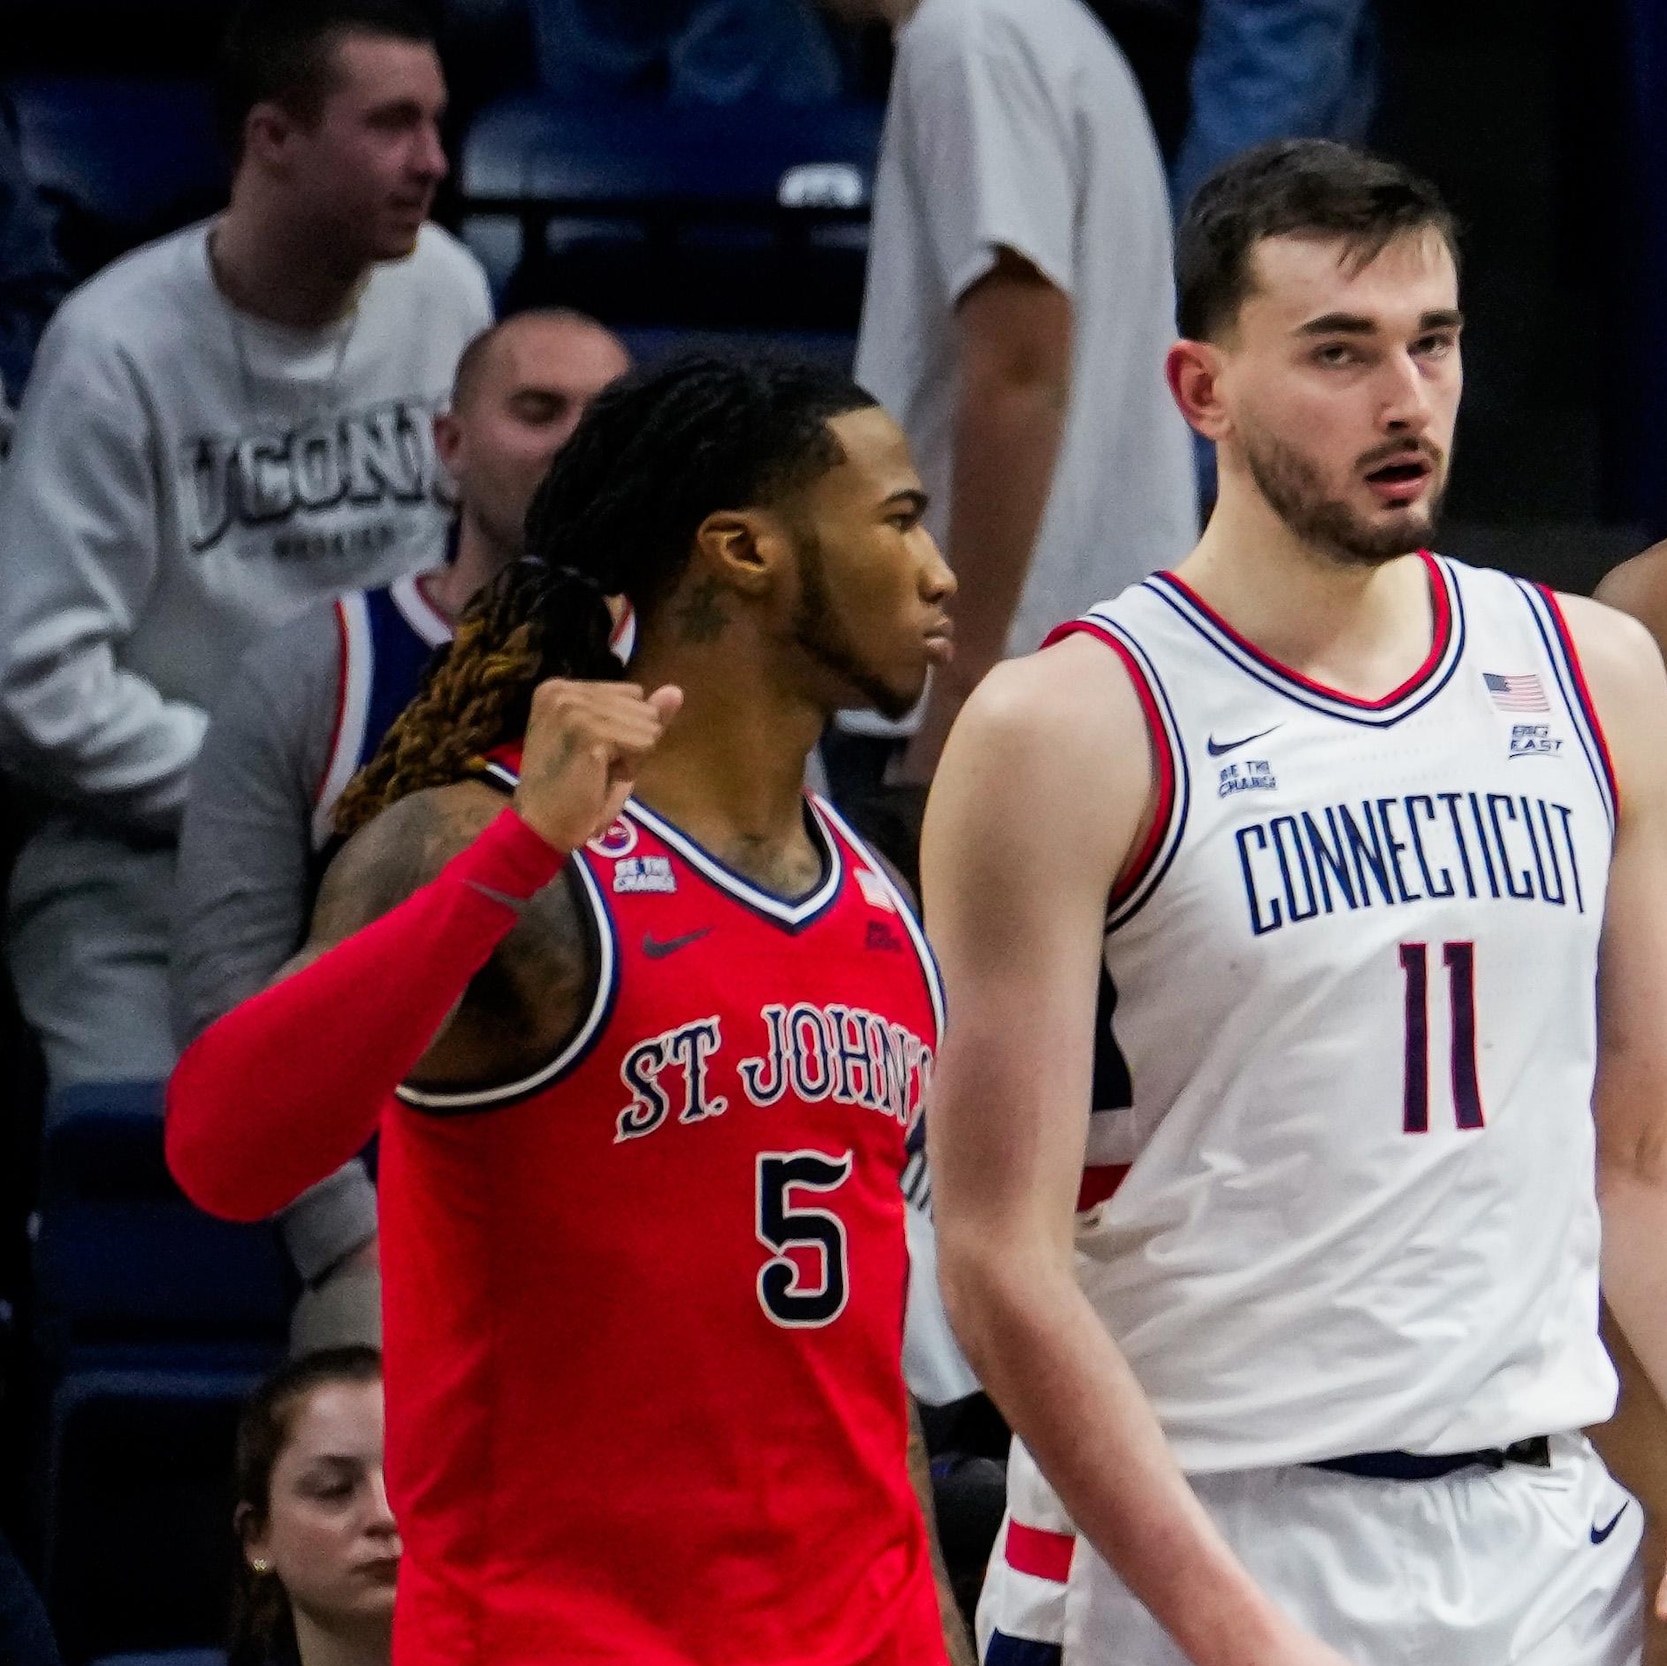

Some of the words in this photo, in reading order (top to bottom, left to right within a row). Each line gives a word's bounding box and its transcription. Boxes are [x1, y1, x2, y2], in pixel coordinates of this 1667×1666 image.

[1509, 739, 1564, 753] EAST
[1236, 791, 1585, 937] CONNECTICUT
[613, 1013, 729, 1144] ST.
[1398, 941, 1485, 1134] 11
[754, 1148, 853, 1329] 5
